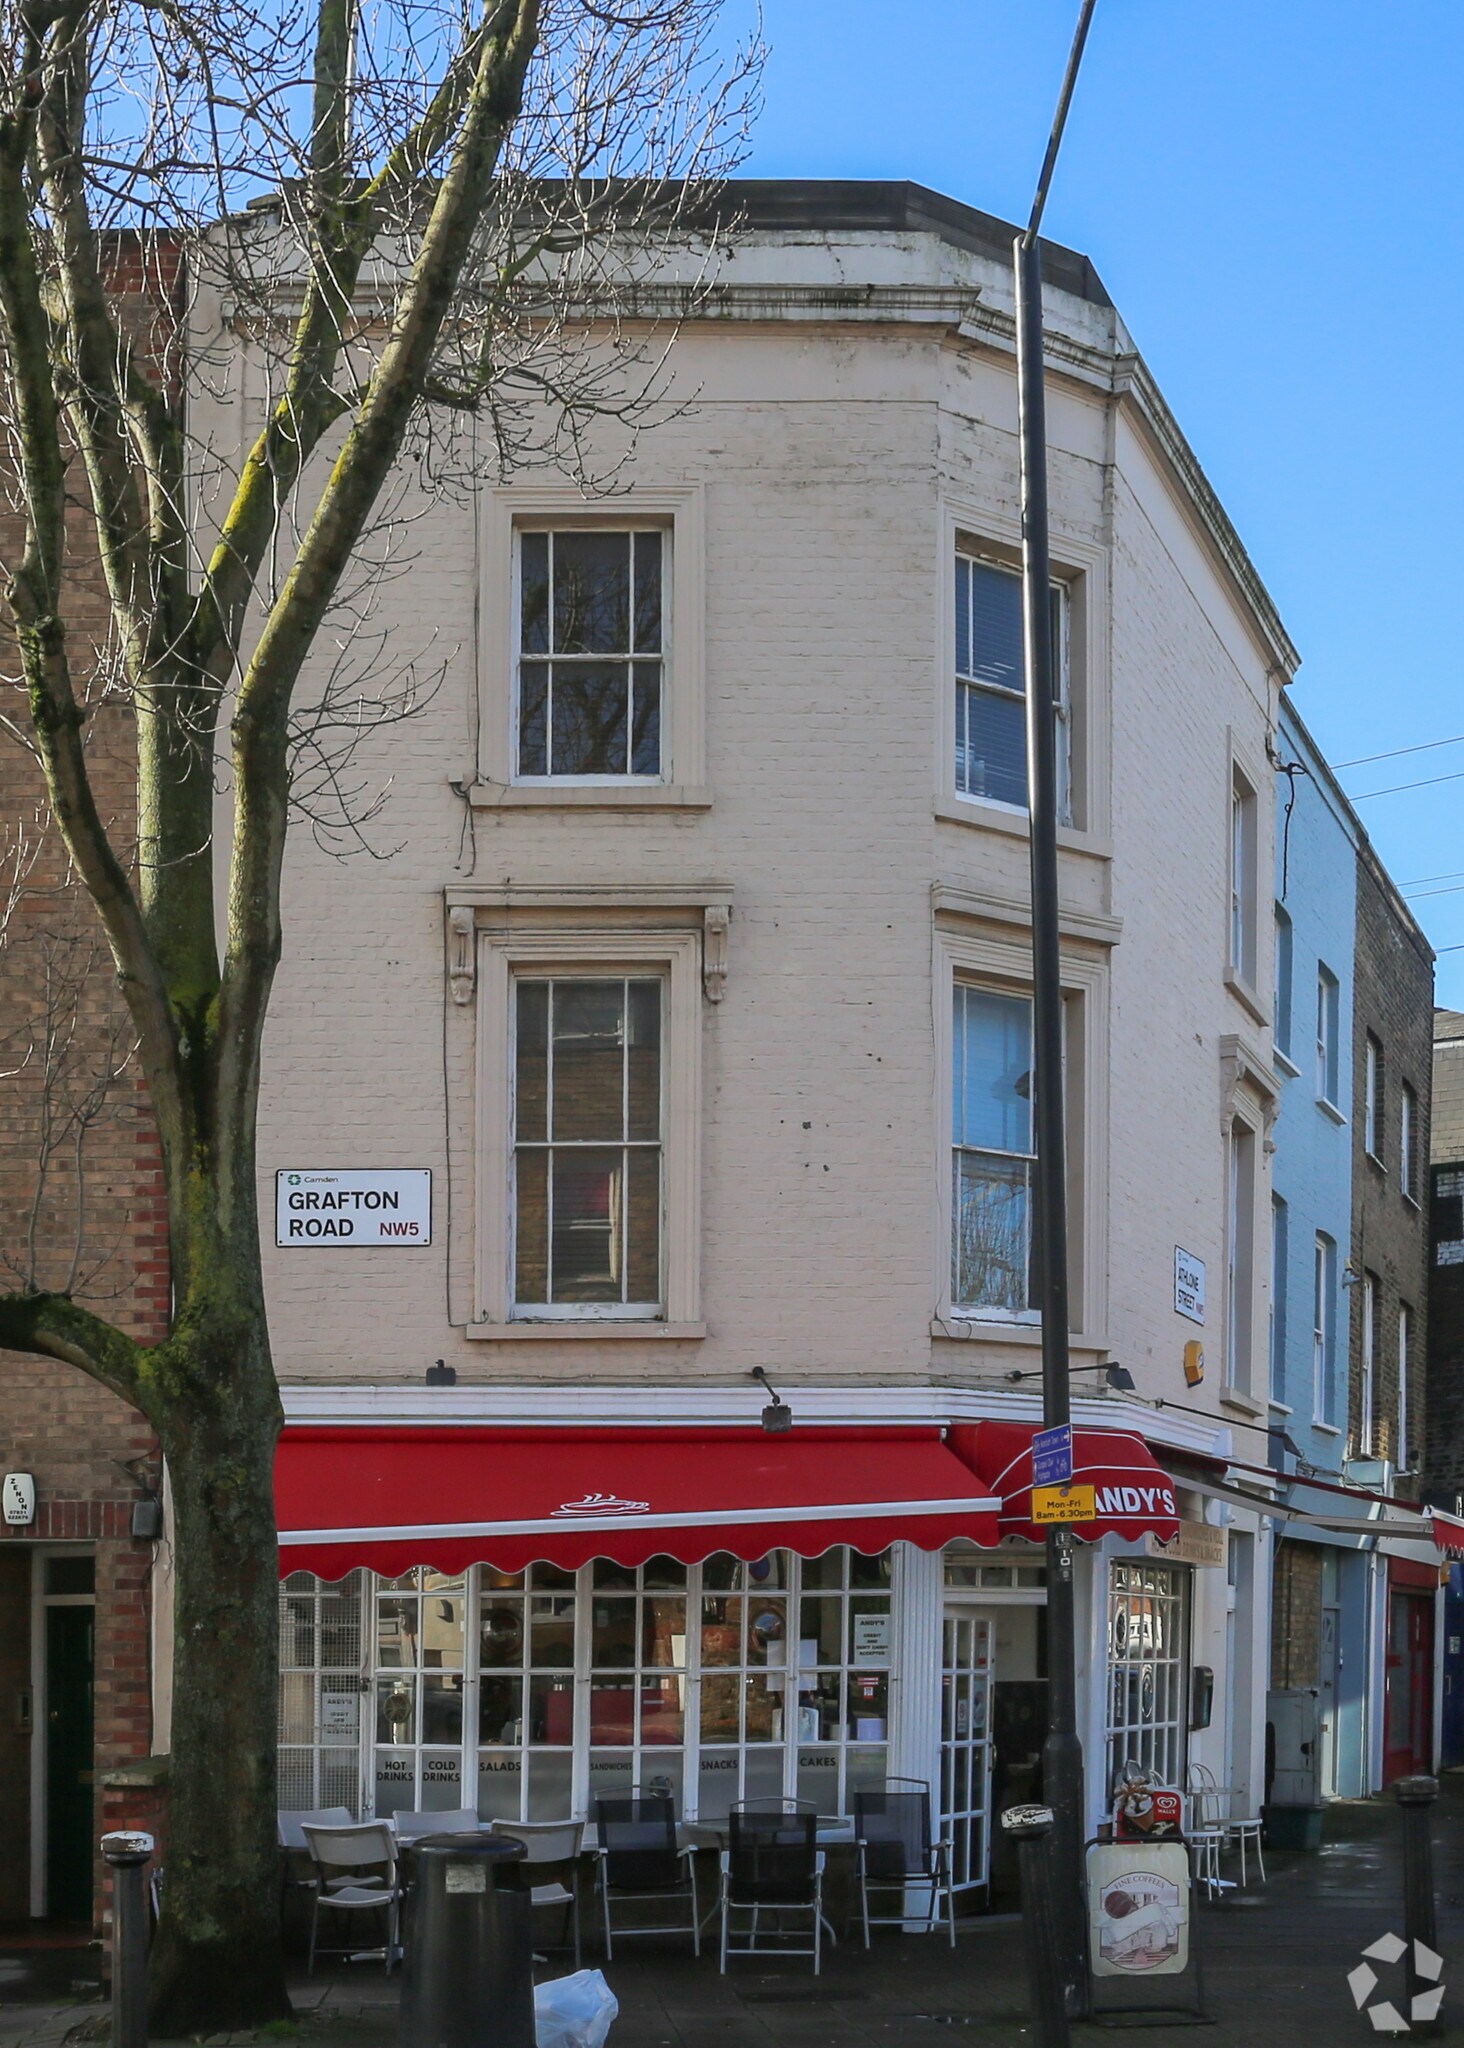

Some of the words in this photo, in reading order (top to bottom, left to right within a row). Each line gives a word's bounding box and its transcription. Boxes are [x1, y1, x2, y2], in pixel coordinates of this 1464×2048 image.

[288, 1191, 398, 1210] GRAFTON
[290, 1218, 354, 1237] ROAD
[380, 1222, 419, 1236] NW5
[10, 1478, 27, 1510] ZENON
[384, 1761, 406, 1771] HOT
[428, 1760, 456, 1771] COLD
[480, 1761, 521, 1772] SALADS
[590, 1762, 633, 1771] SANDWICHES
[701, 1758, 738, 1771] SNACKS
[800, 1756, 837, 1768] CAKES
[376, 1771, 414, 1782] DRINKS
[423, 1771, 461, 1783] DRINKS
[1114, 1877, 1132, 1889] FINE
[1133, 1875, 1165, 1889] COFFEES
